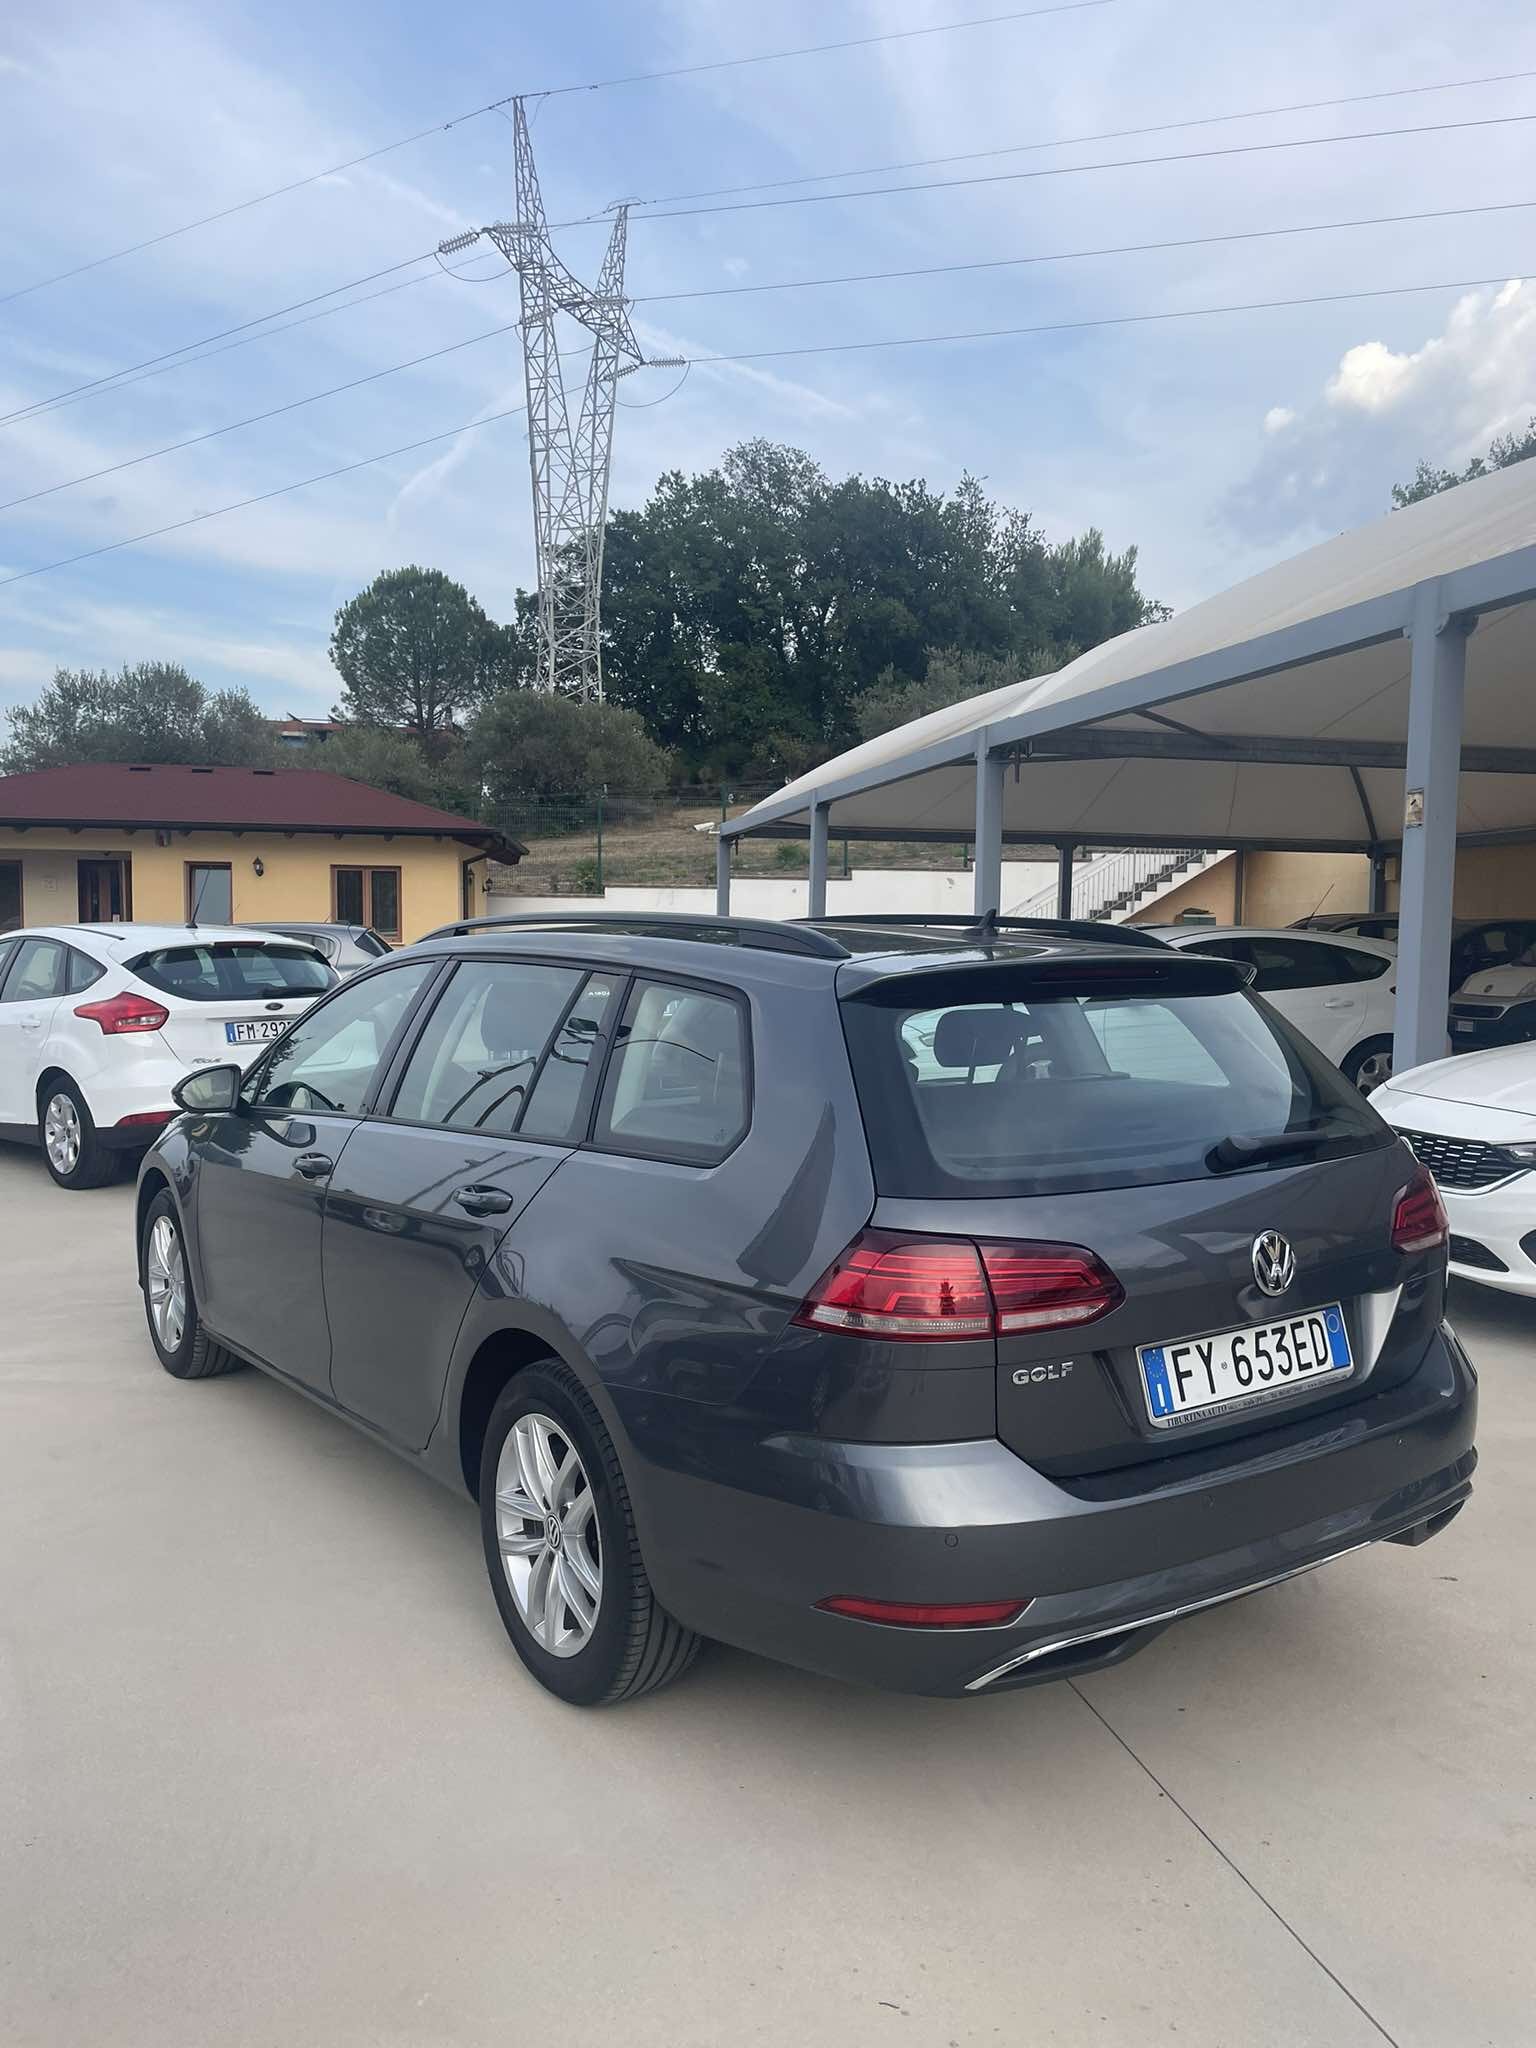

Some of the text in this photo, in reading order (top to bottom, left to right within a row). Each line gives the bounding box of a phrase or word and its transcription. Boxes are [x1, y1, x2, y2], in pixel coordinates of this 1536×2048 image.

[236, 1022, 291, 1040] FM 292
[1171, 1318, 1329, 1402] FY 653ED
[1012, 1361, 1074, 1385] GOLF
